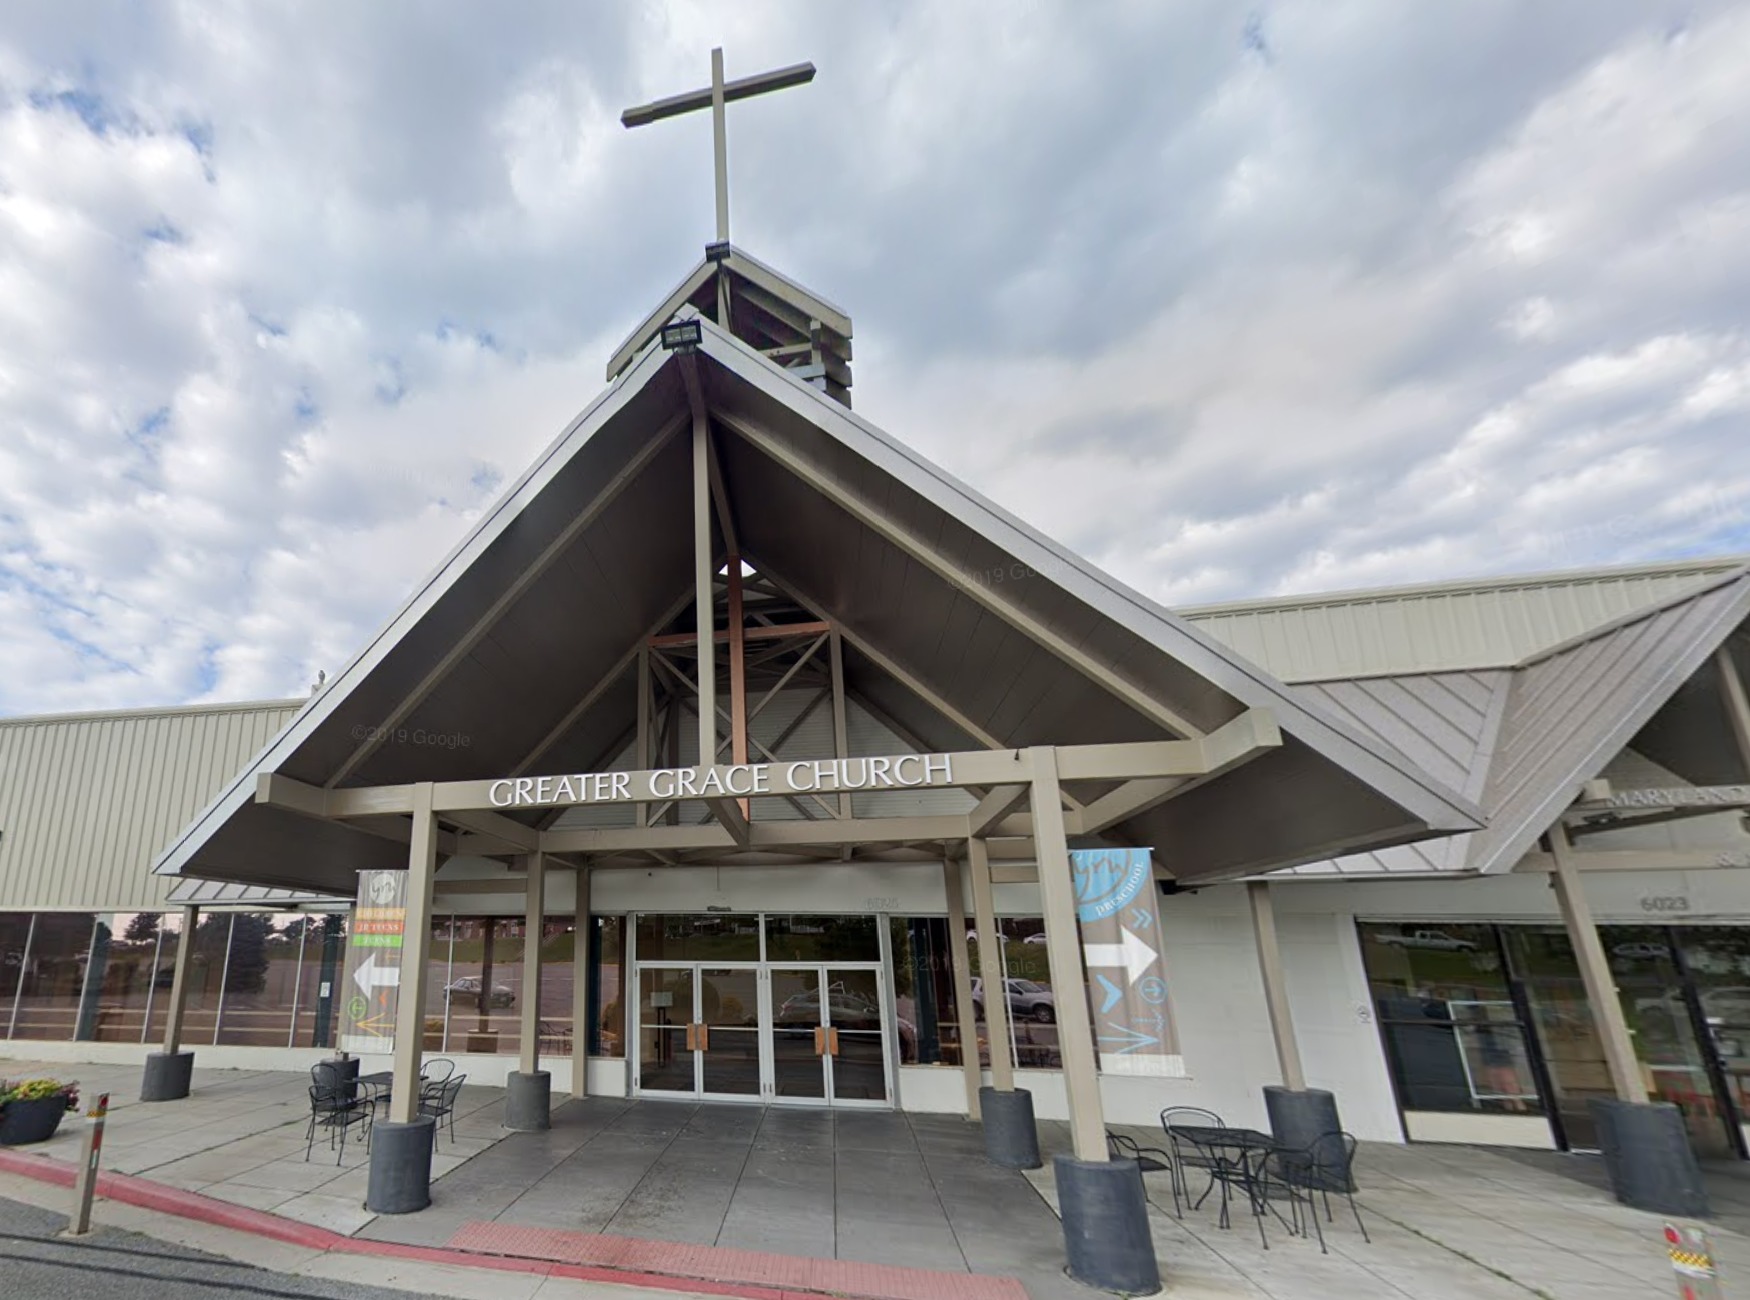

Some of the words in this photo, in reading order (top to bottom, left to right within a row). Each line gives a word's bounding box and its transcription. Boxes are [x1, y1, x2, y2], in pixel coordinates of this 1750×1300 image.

[489, 772, 632, 807] GREATER
[649, 765, 769, 798] GRACE
[787, 755, 953, 791] CHURCH
[1095, 862, 1144, 916] PRESCHOOL
[1641, 897, 1690, 911] 6023
